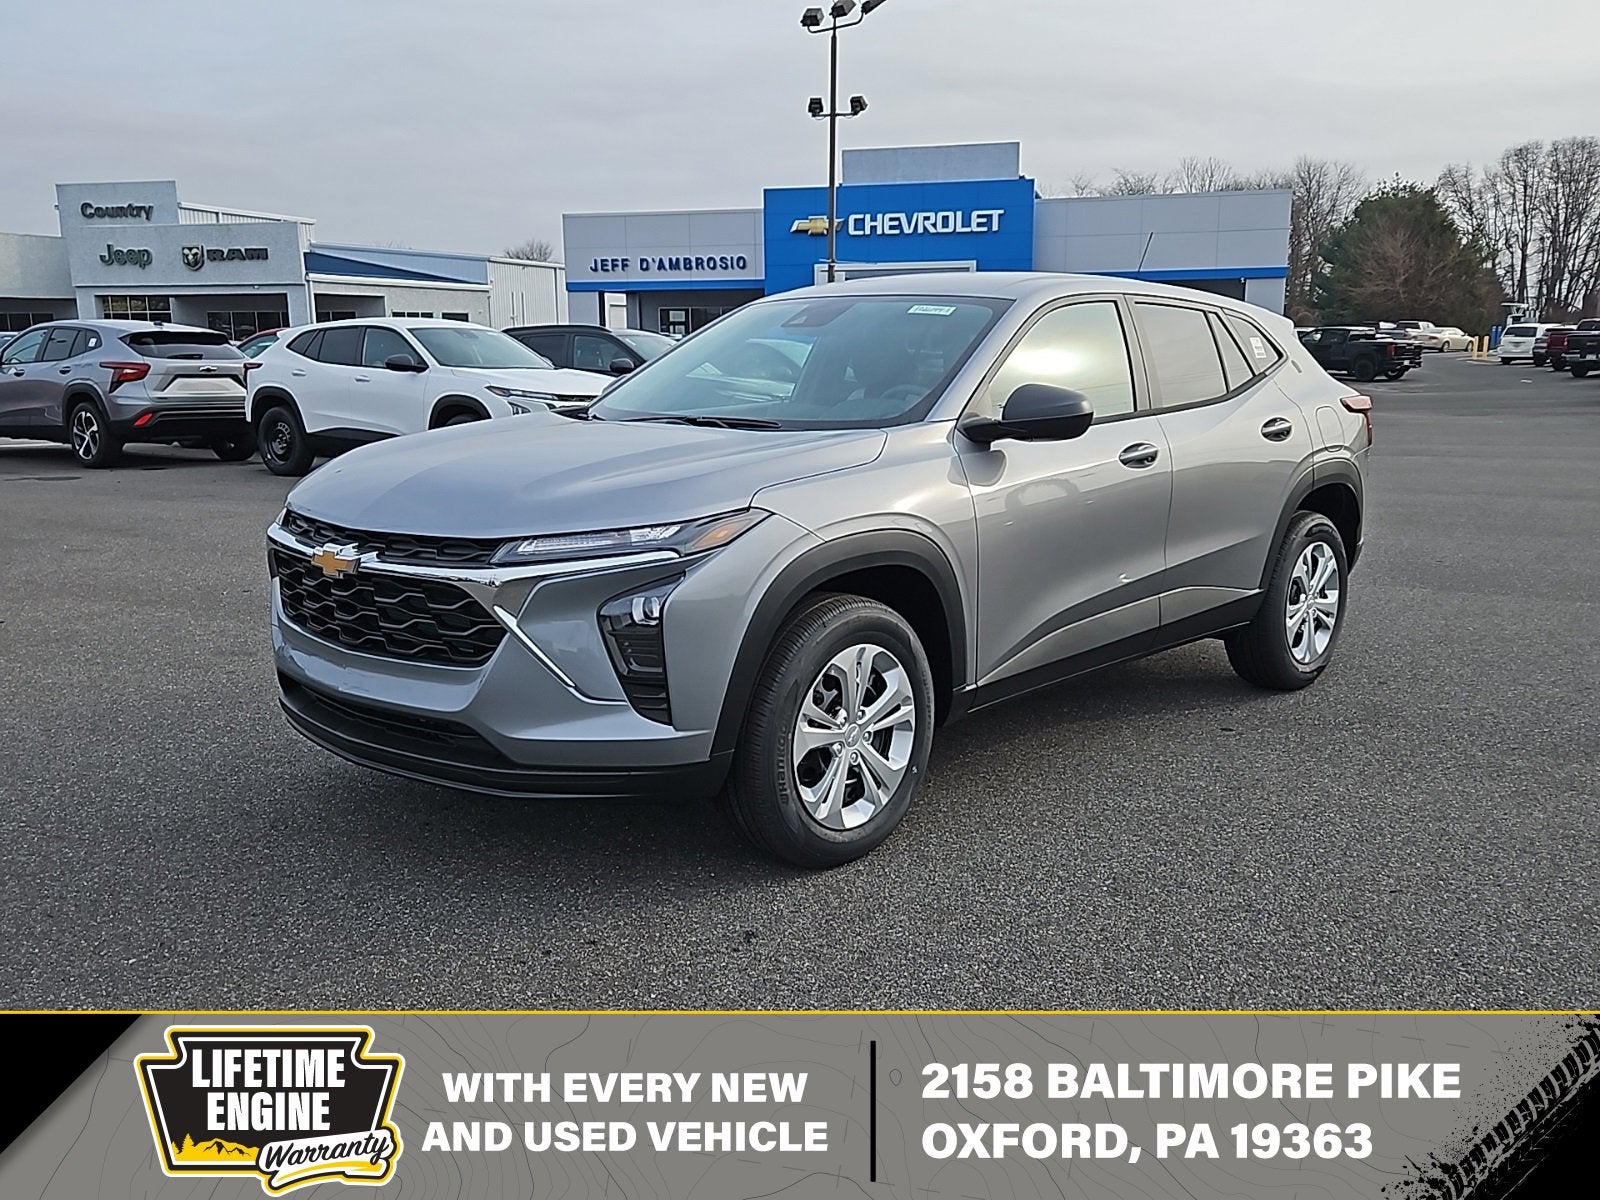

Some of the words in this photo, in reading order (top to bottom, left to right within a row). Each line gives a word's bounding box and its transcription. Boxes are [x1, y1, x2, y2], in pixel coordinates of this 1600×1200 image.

[80, 202, 154, 221] Country
[848, 209, 1005, 236] CHEVROLET
[99, 243, 153, 270] Jeep
[206, 247, 268, 262] RAM
[589, 258, 630, 272] JEFF
[639, 256, 747, 272] D'AMBROSIO
